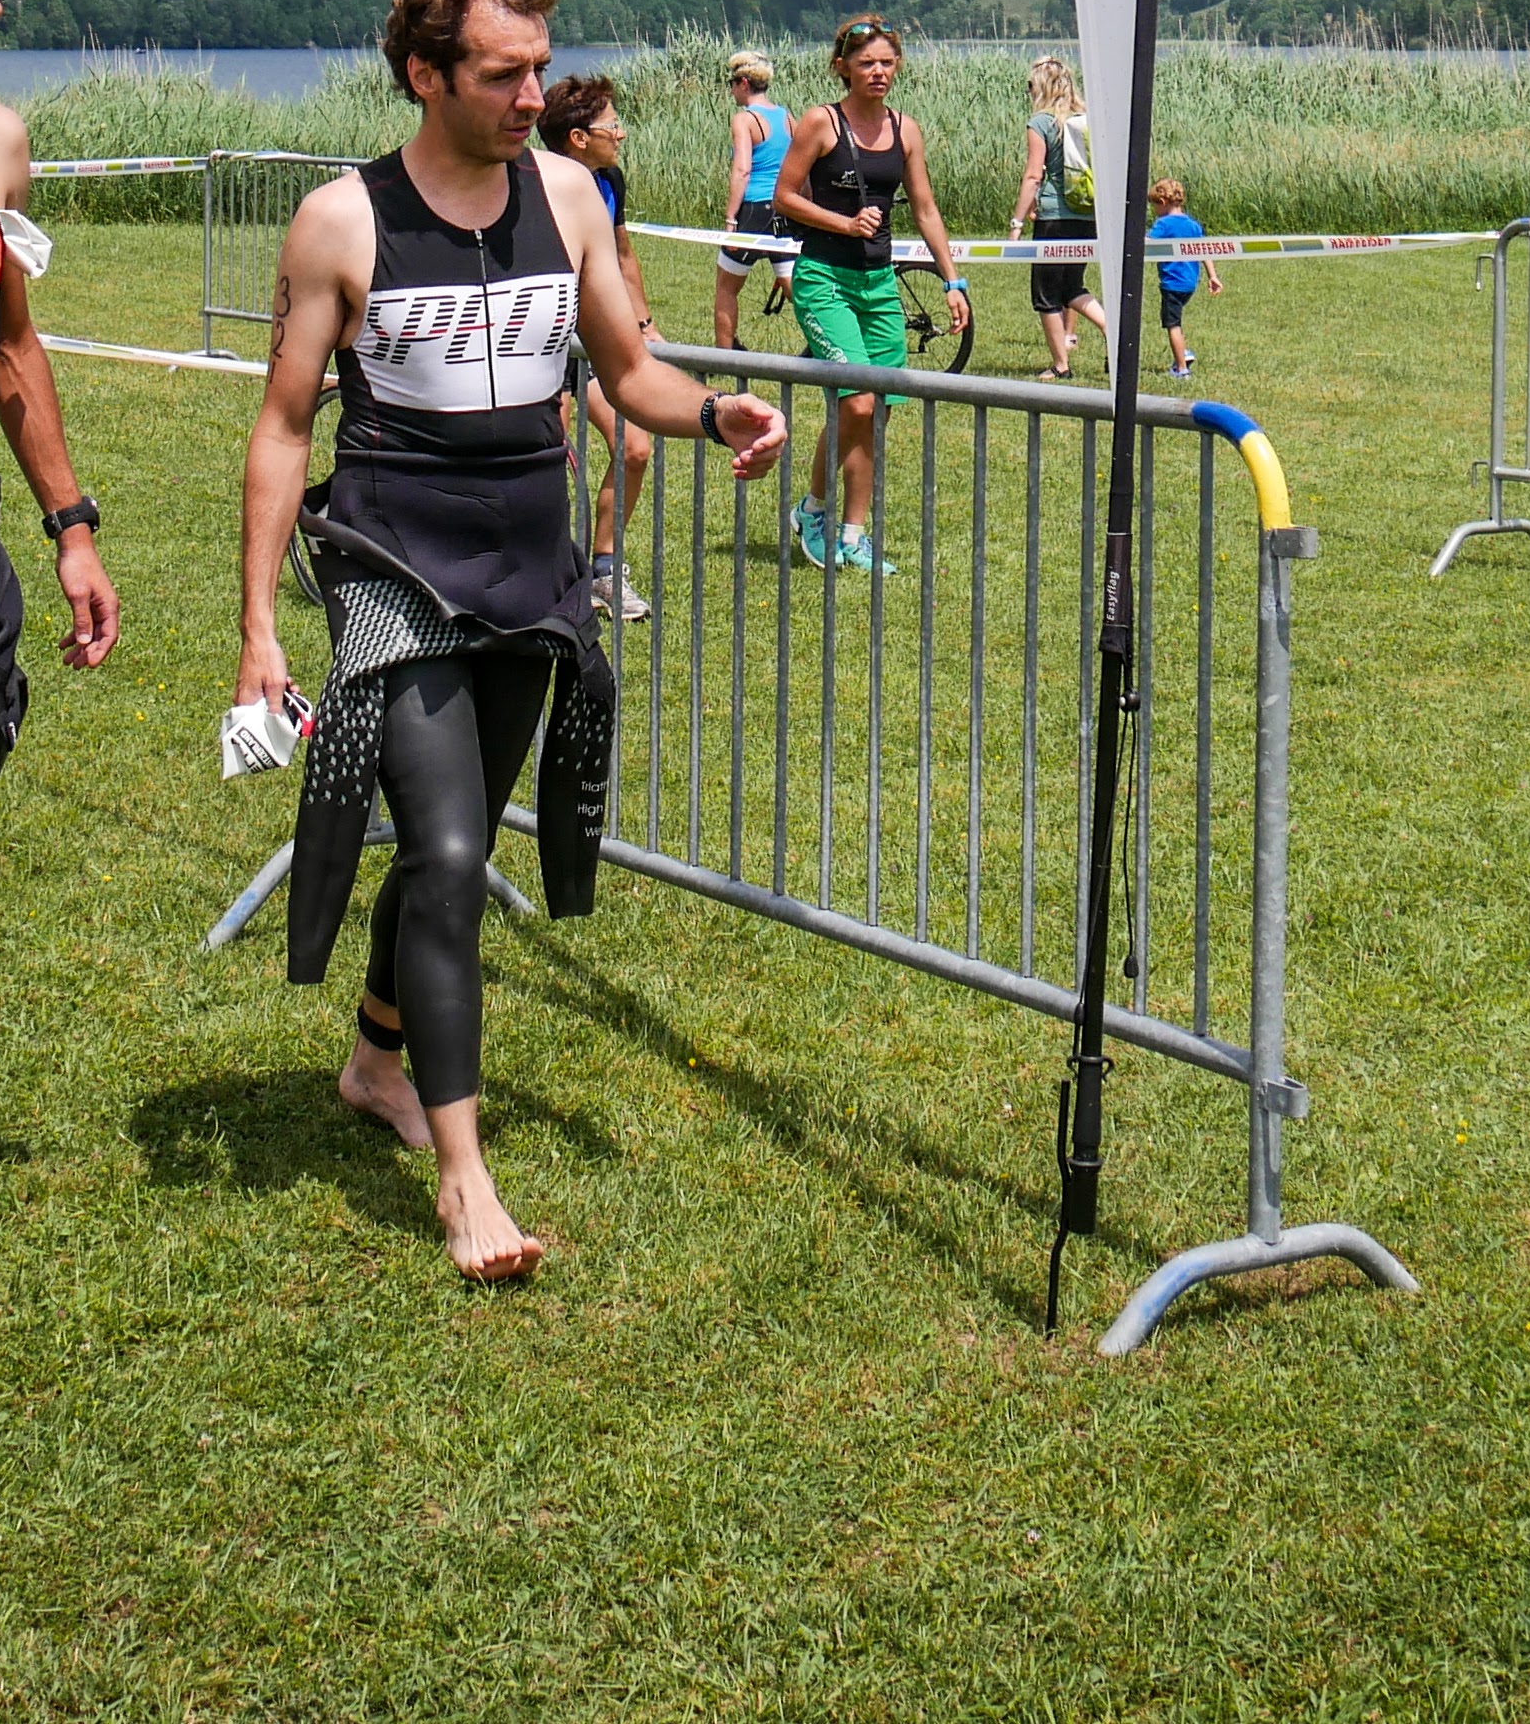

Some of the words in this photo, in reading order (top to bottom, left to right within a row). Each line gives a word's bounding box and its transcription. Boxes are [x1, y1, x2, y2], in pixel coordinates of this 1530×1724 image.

[1043, 244, 1094, 258] RAIFFEISEN
[1180, 241, 1235, 256] RAIFFEISEN
[1106, 570, 1120, 621] Easyflag
[577, 802, 604, 817] High
[584, 825, 603, 837] We
